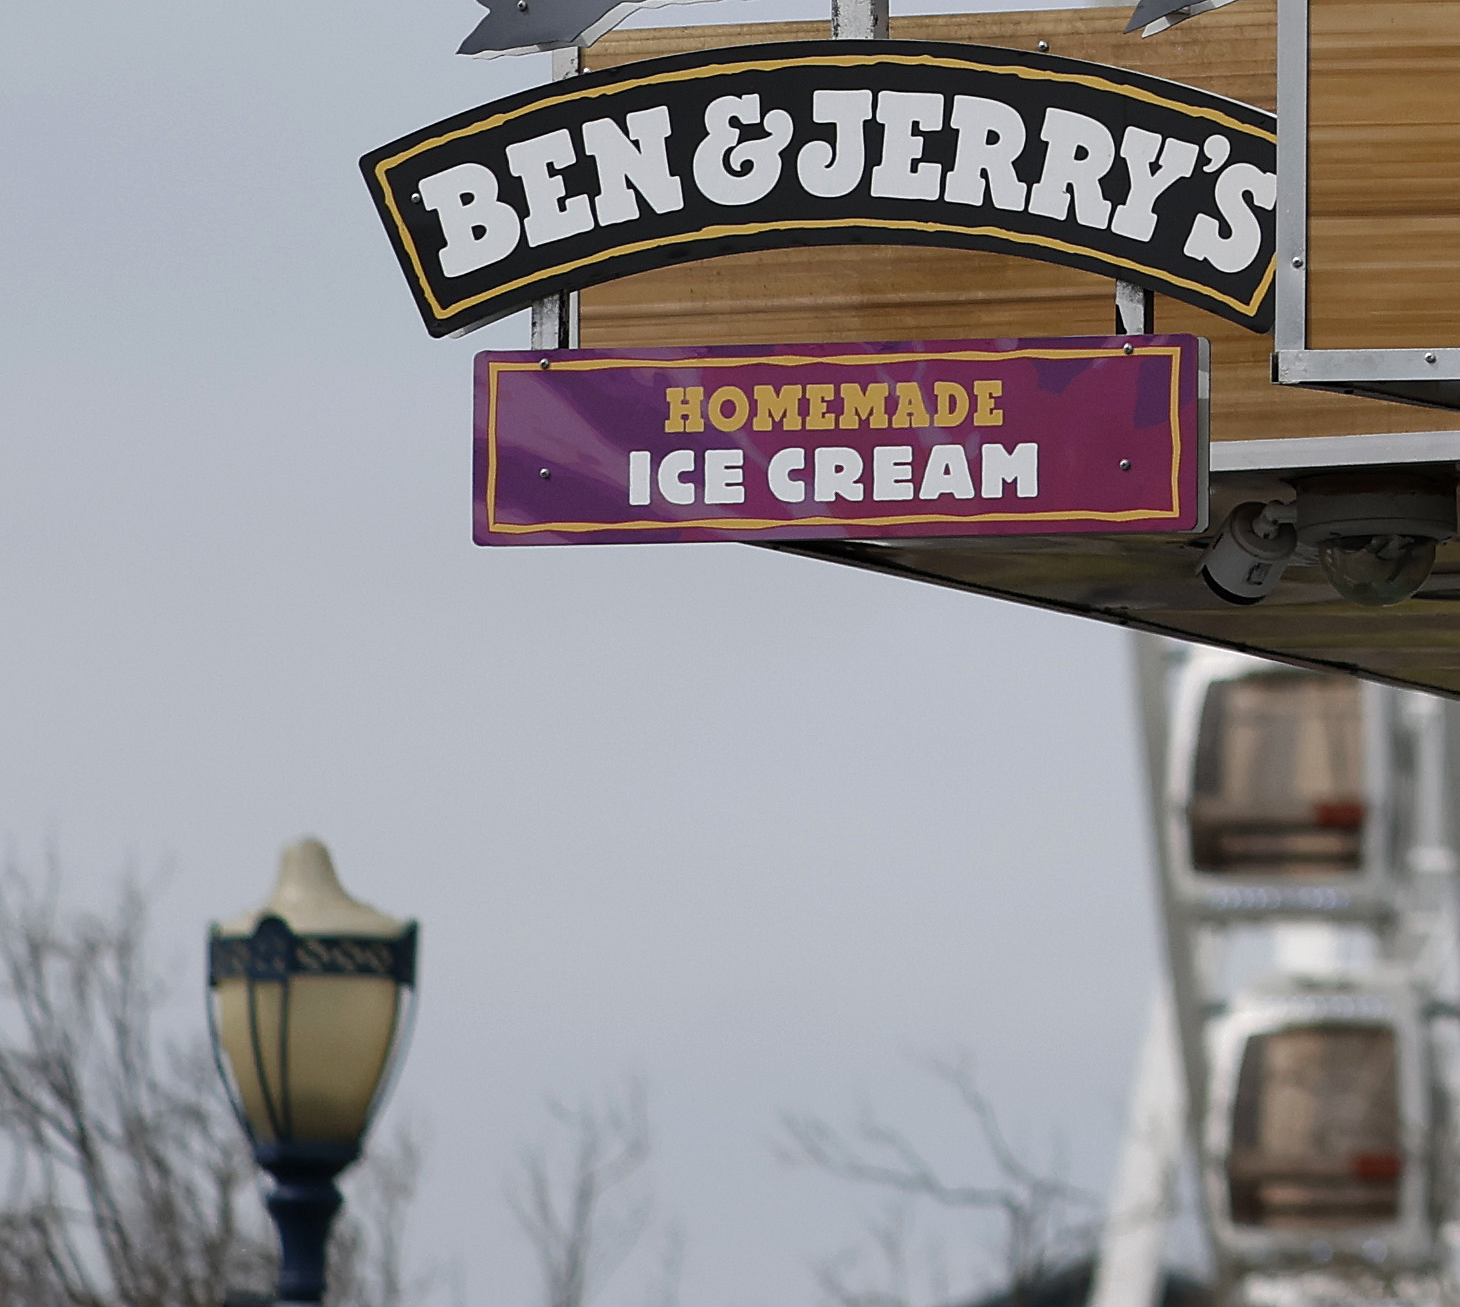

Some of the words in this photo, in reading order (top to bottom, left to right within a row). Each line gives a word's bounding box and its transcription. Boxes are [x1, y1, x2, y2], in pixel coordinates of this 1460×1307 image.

[664, 380, 1004, 434] HOMEMADE
[629, 447, 746, 506] ICE
[767, 442, 1038, 503] CREAM
